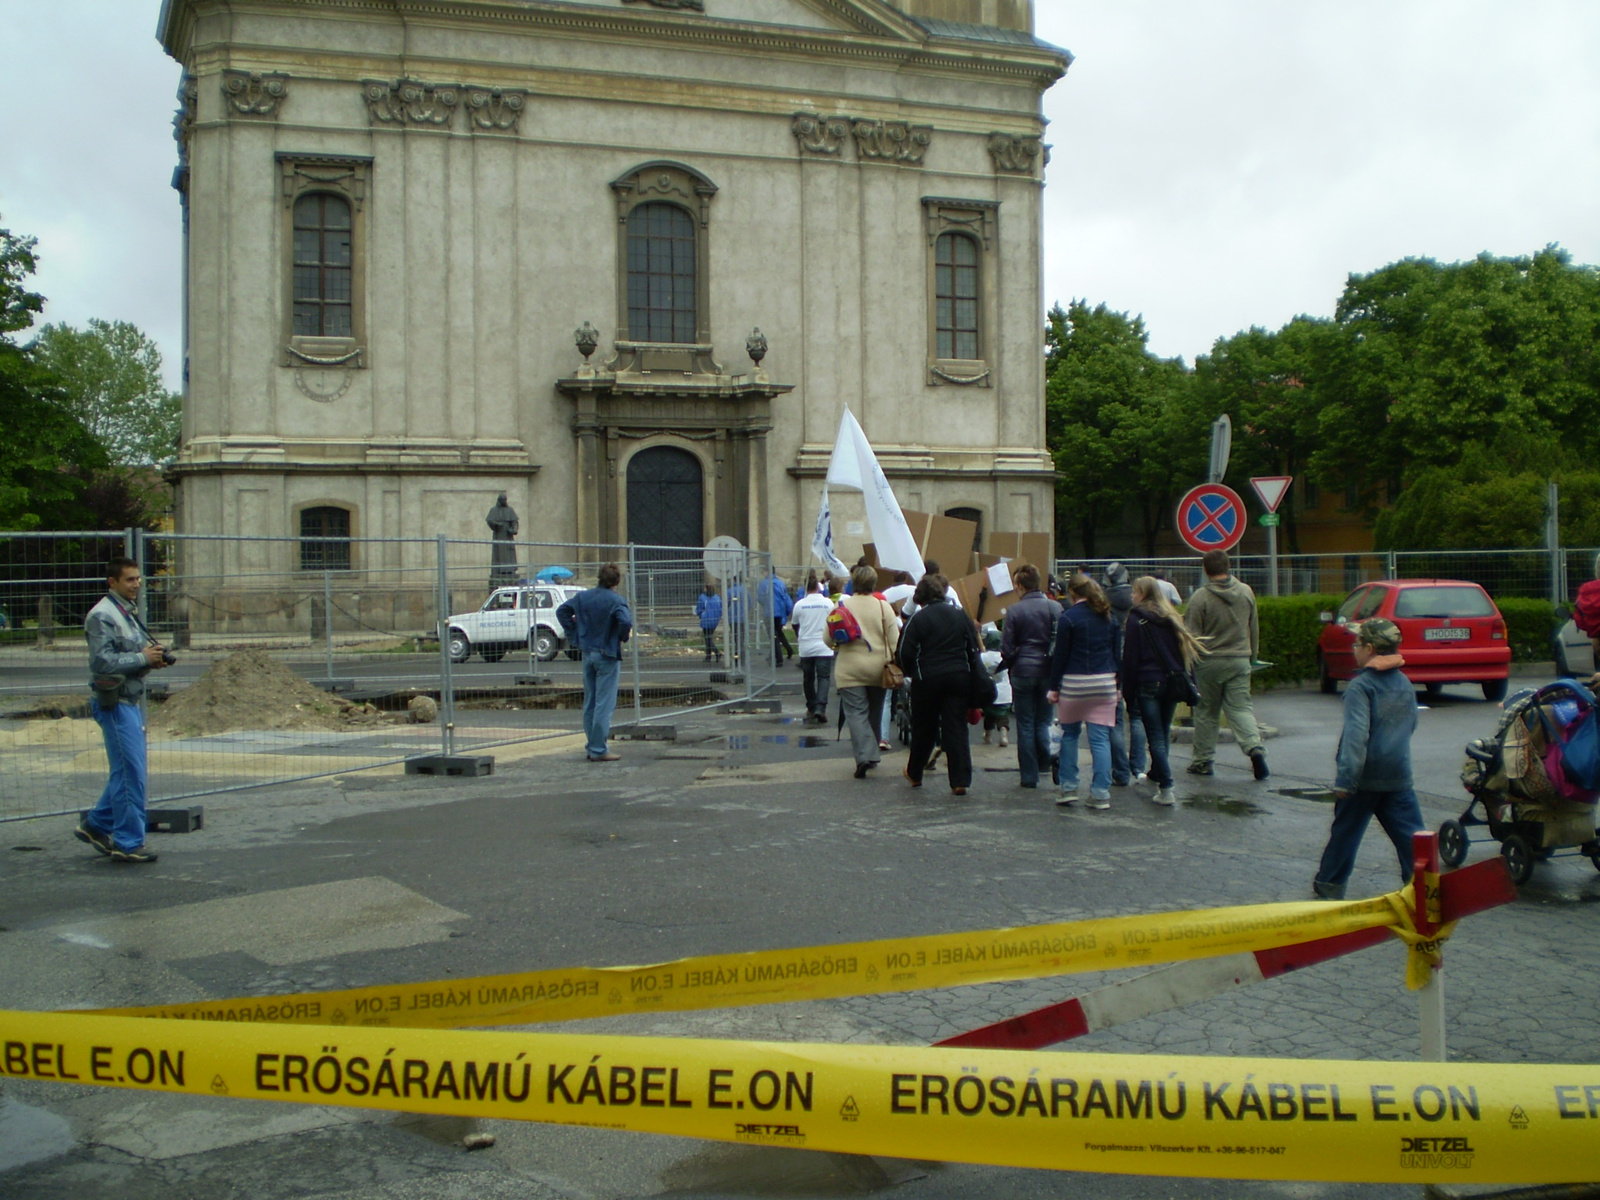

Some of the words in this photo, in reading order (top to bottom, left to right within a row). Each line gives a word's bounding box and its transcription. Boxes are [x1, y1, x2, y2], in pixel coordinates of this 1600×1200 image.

[0, 1041, 79, 1080] BEL
[89, 1045, 186, 1087] E.ON
[546, 1054, 693, 1109] KÁBEL
[707, 1068, 814, 1113] E.ON
[1203, 1072, 1359, 1123] KÁBEL
[1370, 1084, 1481, 1123] E.ON
[735, 1123, 806, 1137] DIETZEL
[1400, 1136, 1476, 1153] DIETZEL
[1400, 1152, 1476, 1169] UNIVOLT
